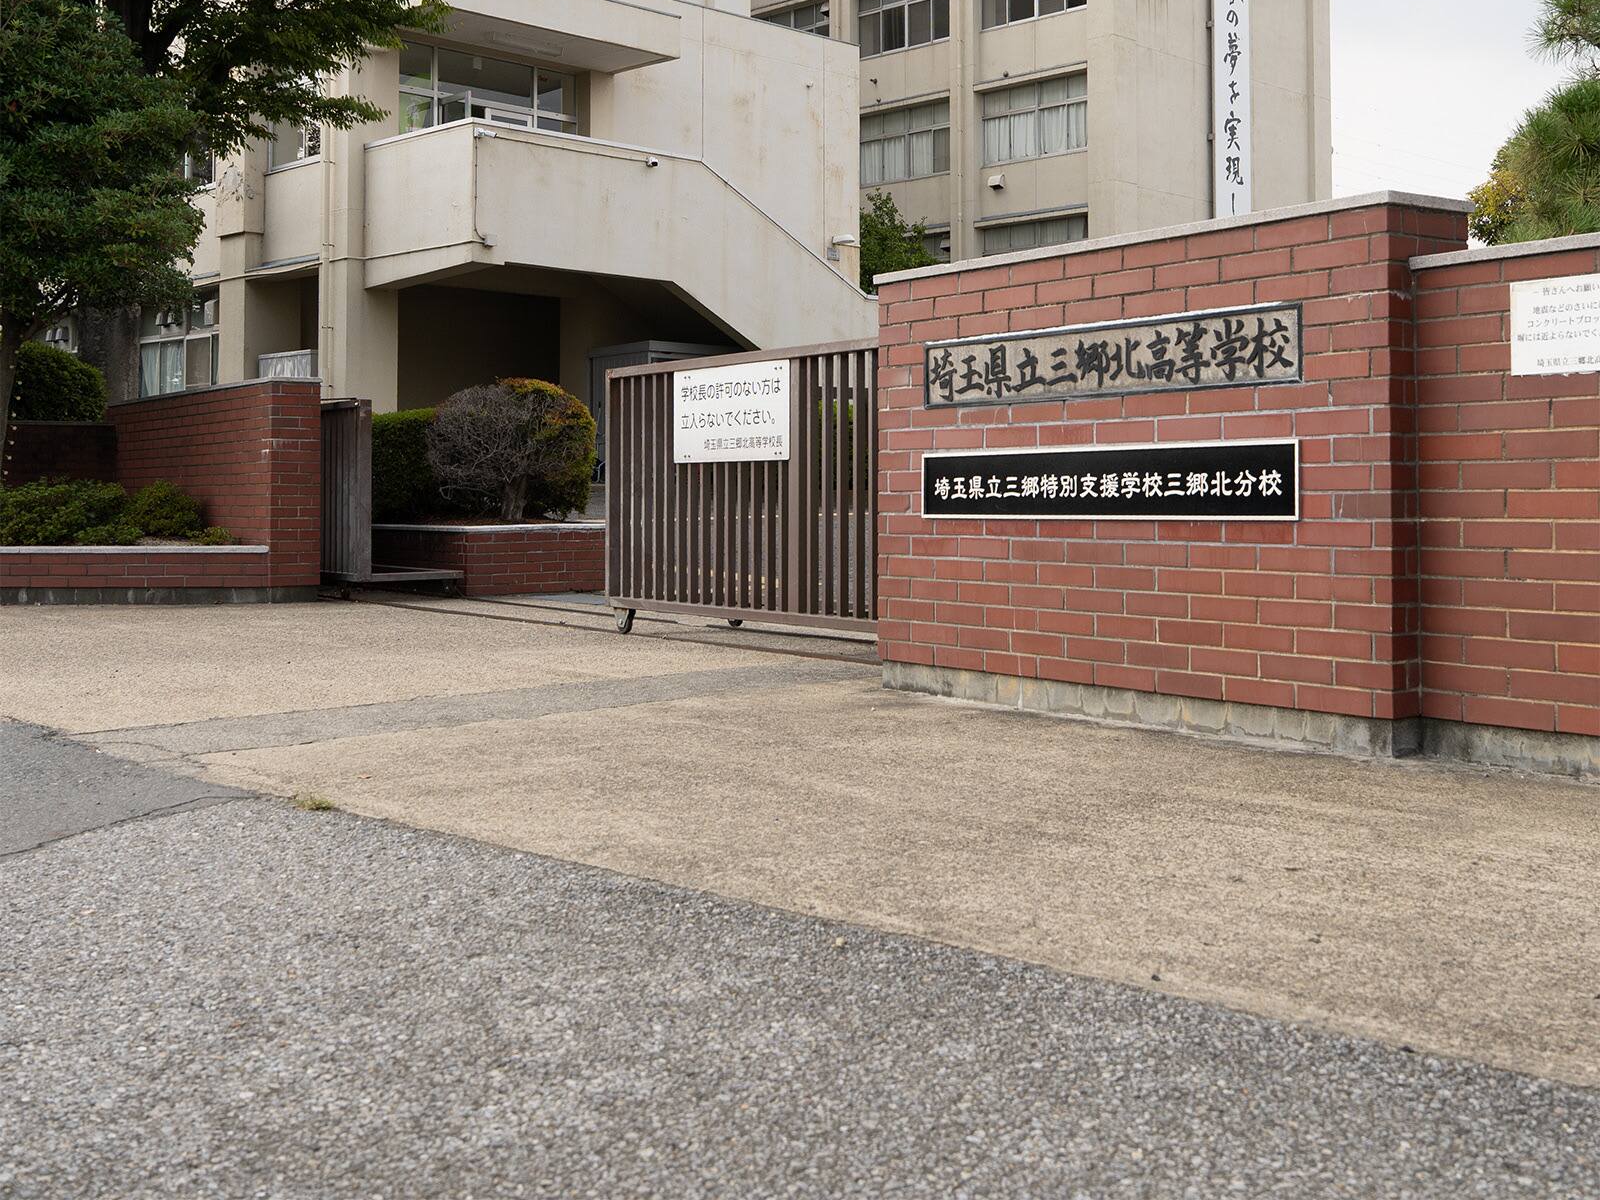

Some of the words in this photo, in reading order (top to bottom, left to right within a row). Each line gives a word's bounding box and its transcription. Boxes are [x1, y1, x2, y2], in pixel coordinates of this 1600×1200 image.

[1532, 300, 1600, 315] 地震などのさいに
[929, 317, 1295, 403] 埼玉県立三郷北高等学校
[681, 377, 781, 402] 学校長の許可のない方は
[681, 409, 775, 430] 立入らないでください。
[704, 435, 783, 451] 埼玉県立三郷北高等学校長
[934, 469, 1283, 500] 埼玉県立三郷特別支援学校三郷北分校
